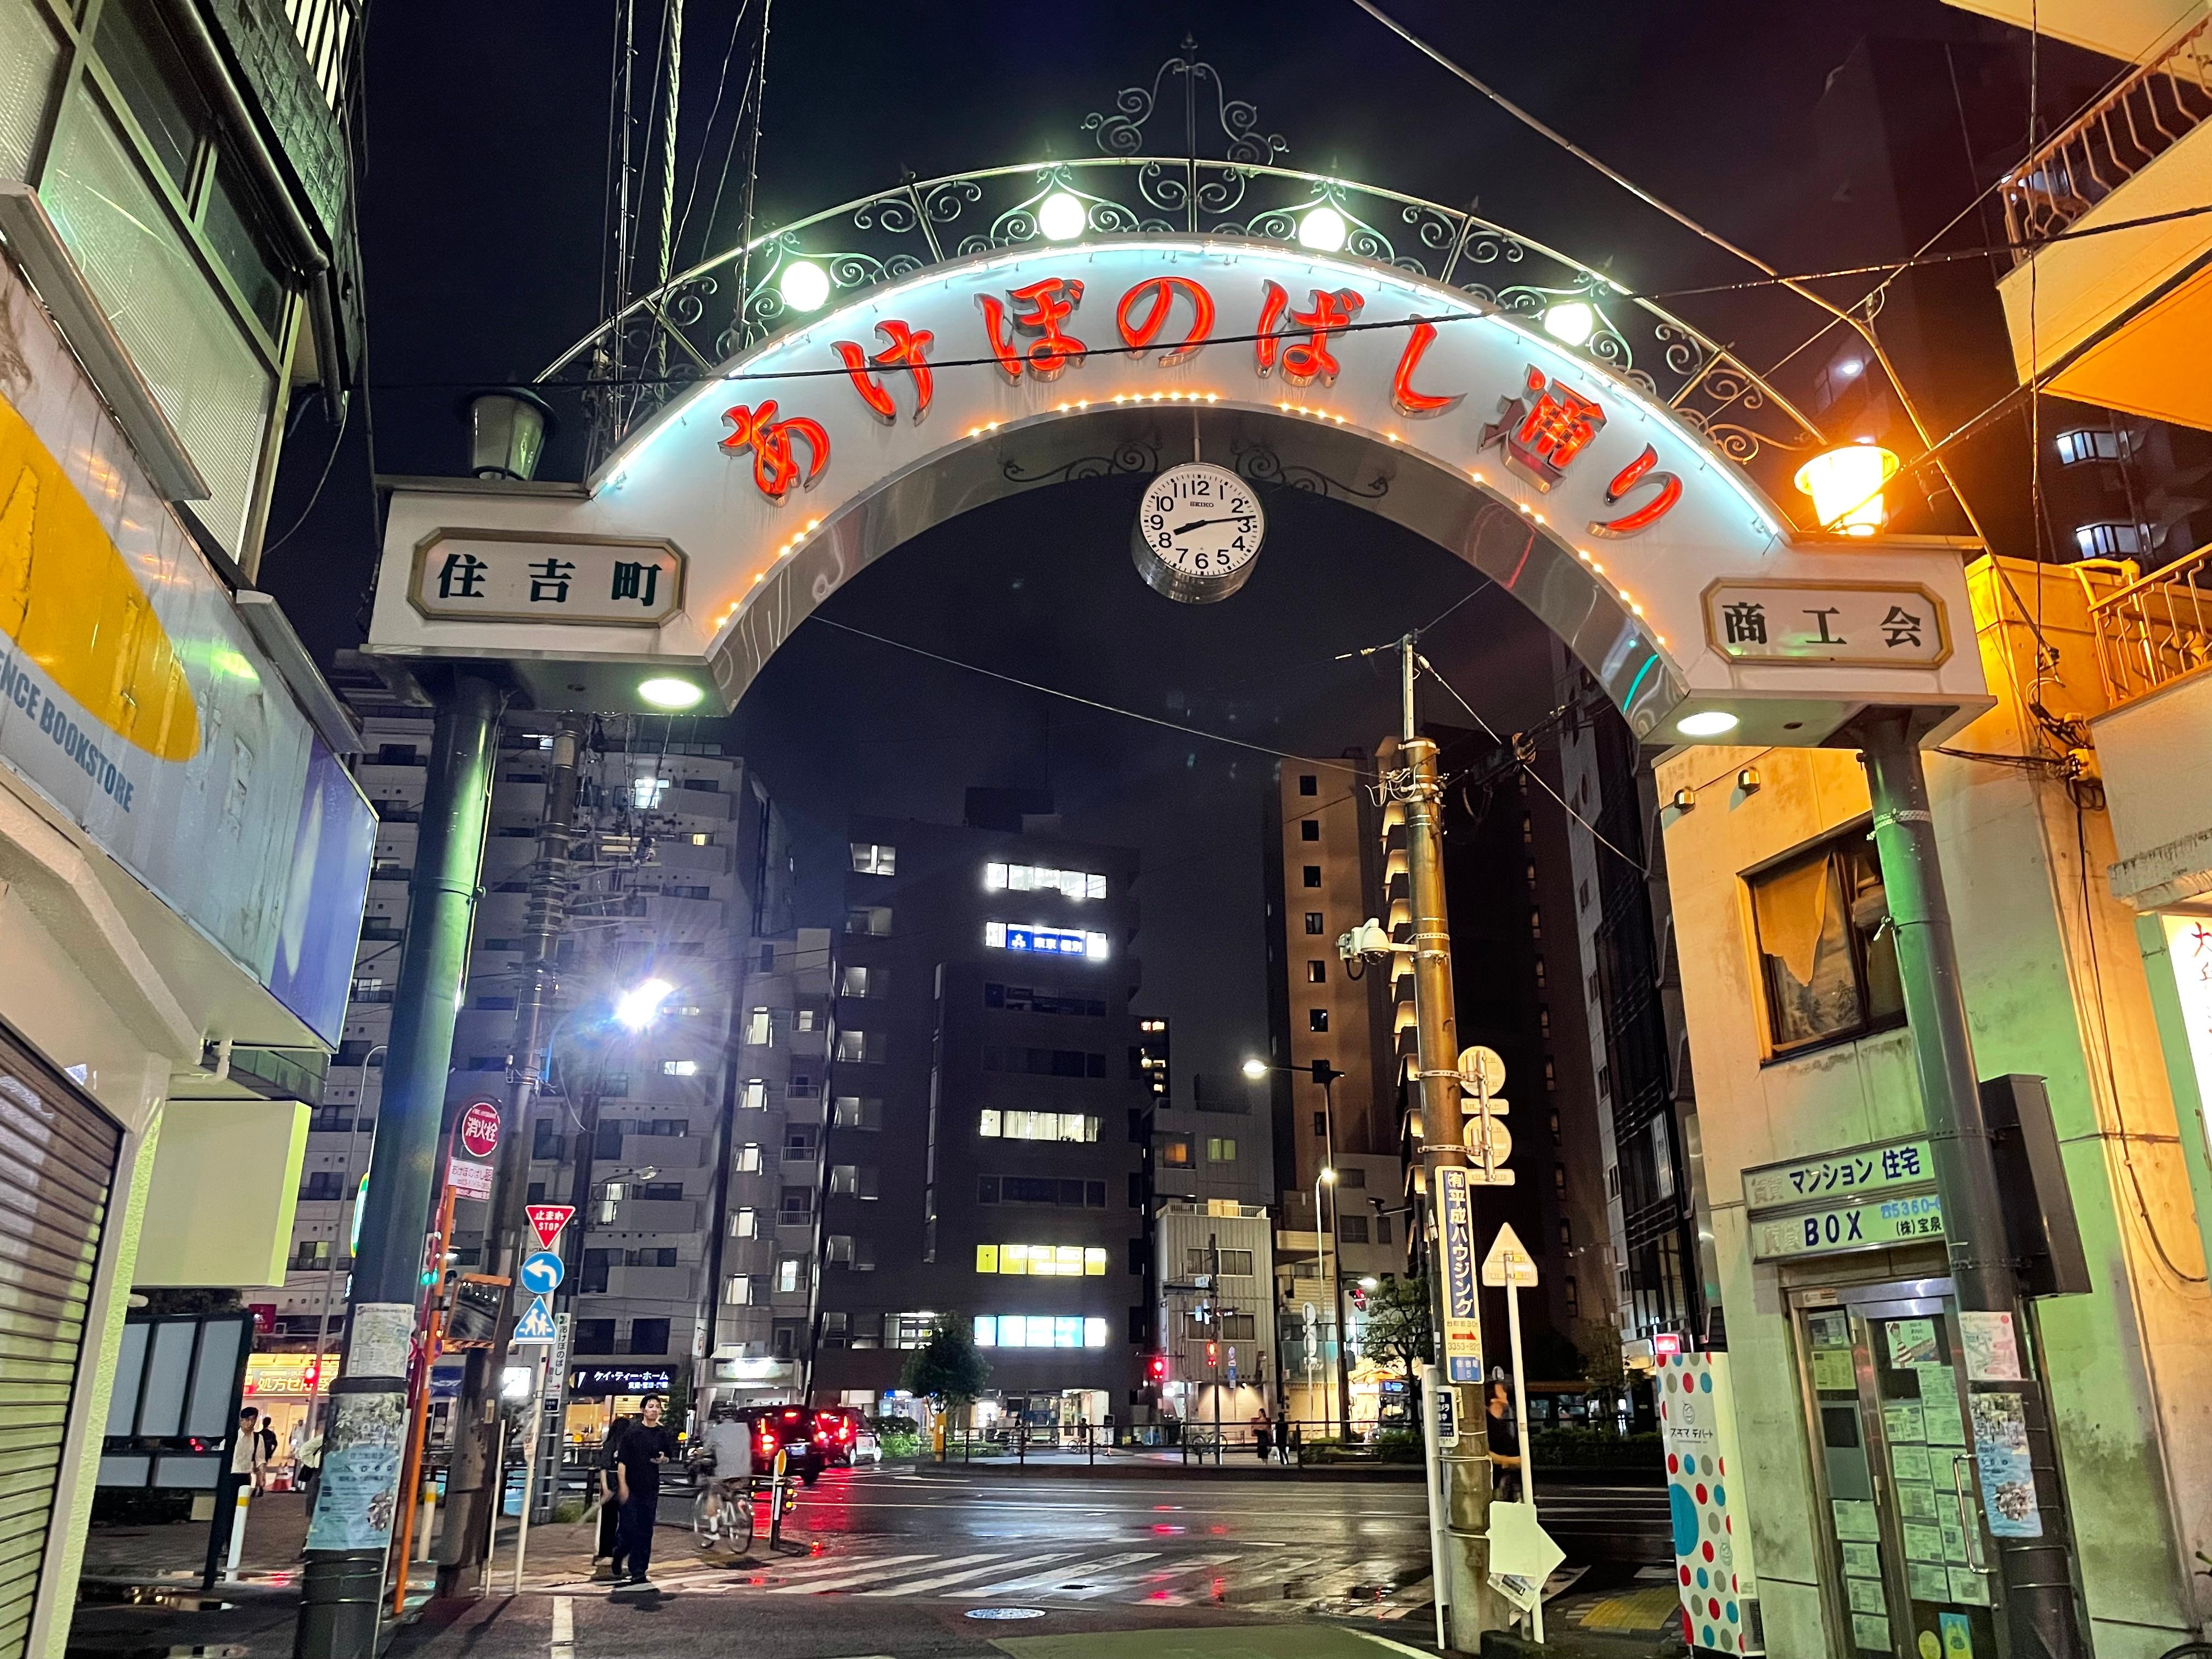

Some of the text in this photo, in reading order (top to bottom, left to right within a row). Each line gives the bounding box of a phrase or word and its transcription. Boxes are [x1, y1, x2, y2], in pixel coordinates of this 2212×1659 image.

[718, 275, 1684, 539] あけぼのばし通り
[1174, 483, 1186, 498] 11
[1192, 481, 1210, 495] 12
[1220, 484, 1223, 500] 1
[1156, 496, 1174, 512] 10
[1231, 498, 1244, 513] 2
[1150, 515, 1164, 530] 9
[1237, 517, 1251, 533] 3
[1159, 532, 1172, 548] 8
[1232, 536, 1245, 551] 4
[1176, 549, 1188, 563] 7
[1195, 553, 1209, 569] 6
[1217, 549, 1230, 565] 5
[437, 554, 662, 606] 住吉町
[1722, 601, 1921, 647] 商工会
[0, 650, 134, 813] NCE BOOKSTORE
[465, 1116, 498, 1142] 消火栓
[534, 1210, 565, 1221] 止まれ
[538, 1222, 559, 1231] STOP
[1804, 1210, 1863, 1246] BOX
